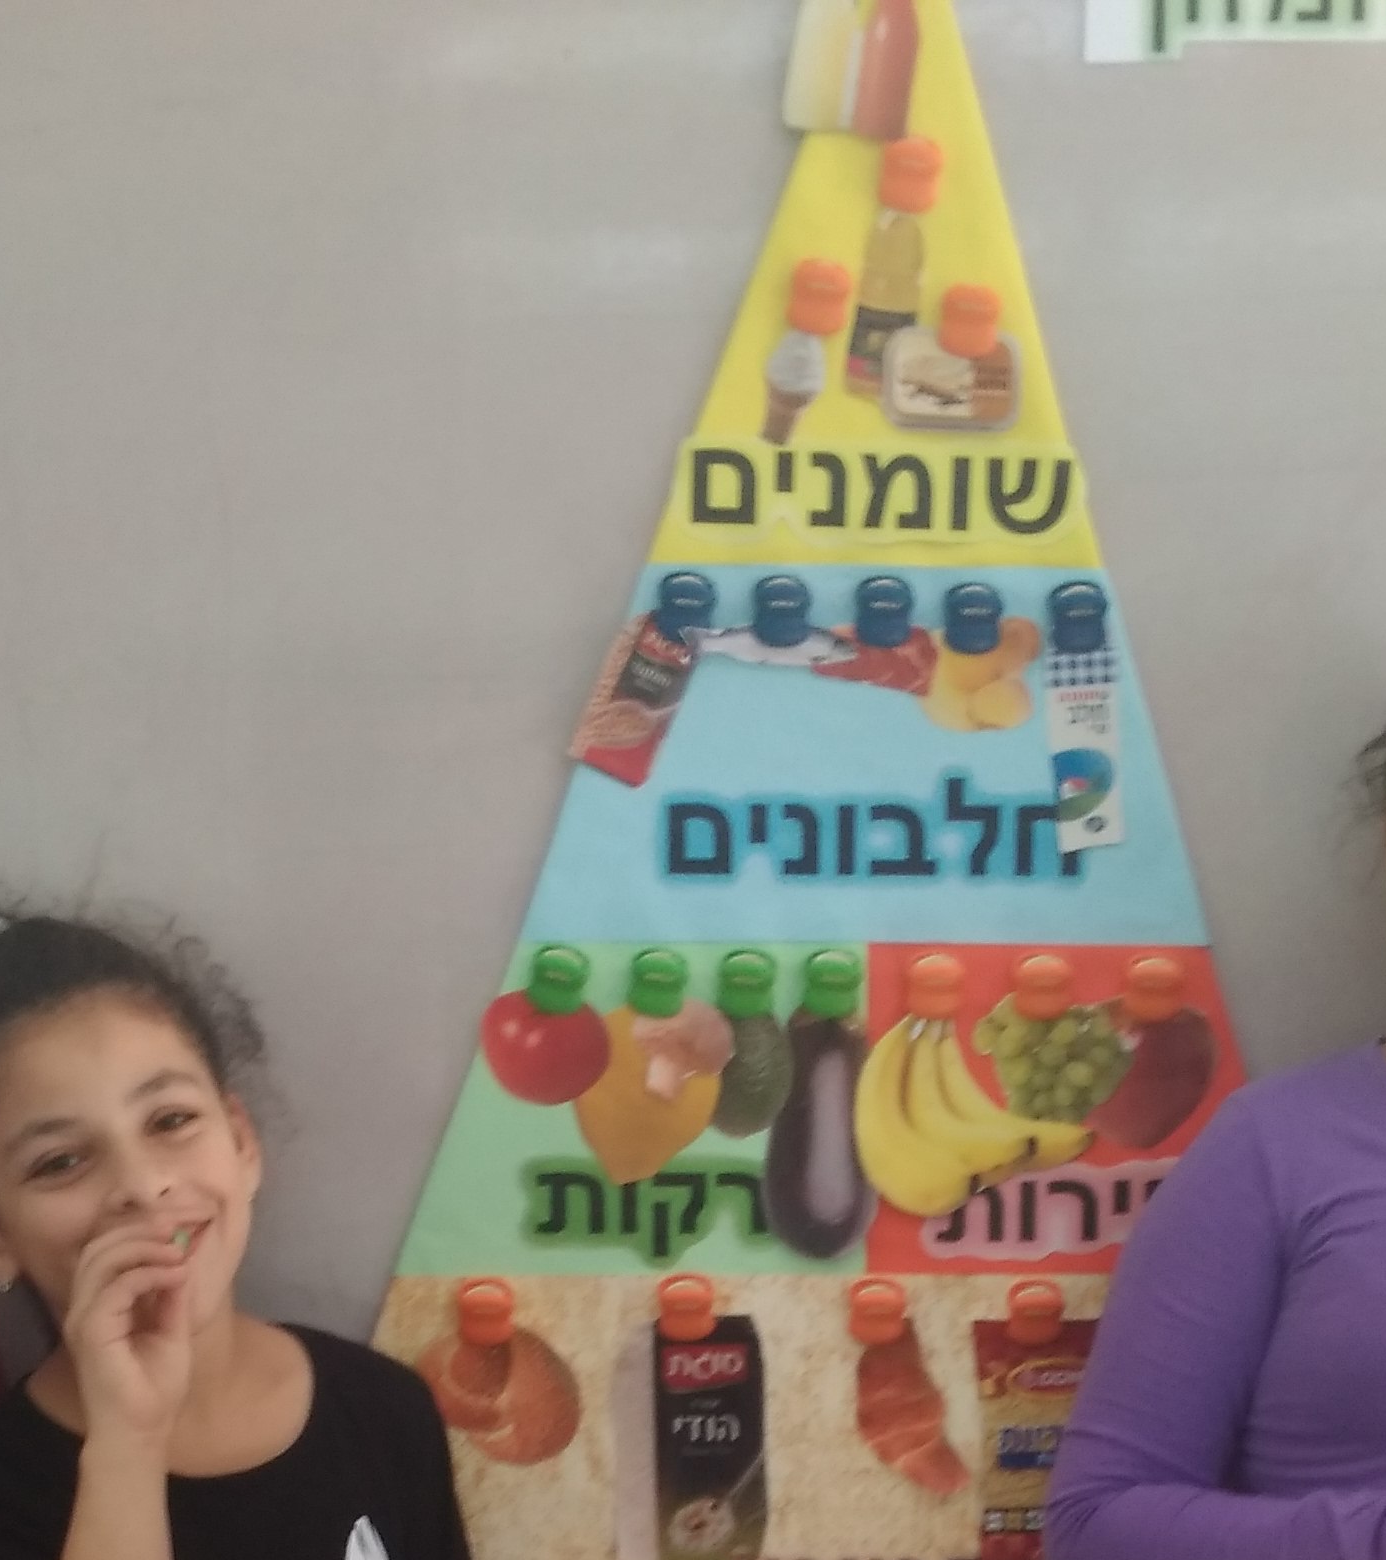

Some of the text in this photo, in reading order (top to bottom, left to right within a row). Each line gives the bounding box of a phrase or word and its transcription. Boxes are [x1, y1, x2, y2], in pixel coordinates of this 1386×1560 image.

[690, 447, 1071, 535] שומנים
[666, 776, 1082, 877] חלבונים
[535, 1171, 768, 1258] רקות
[935, 1178, 1164, 1243] ירות
